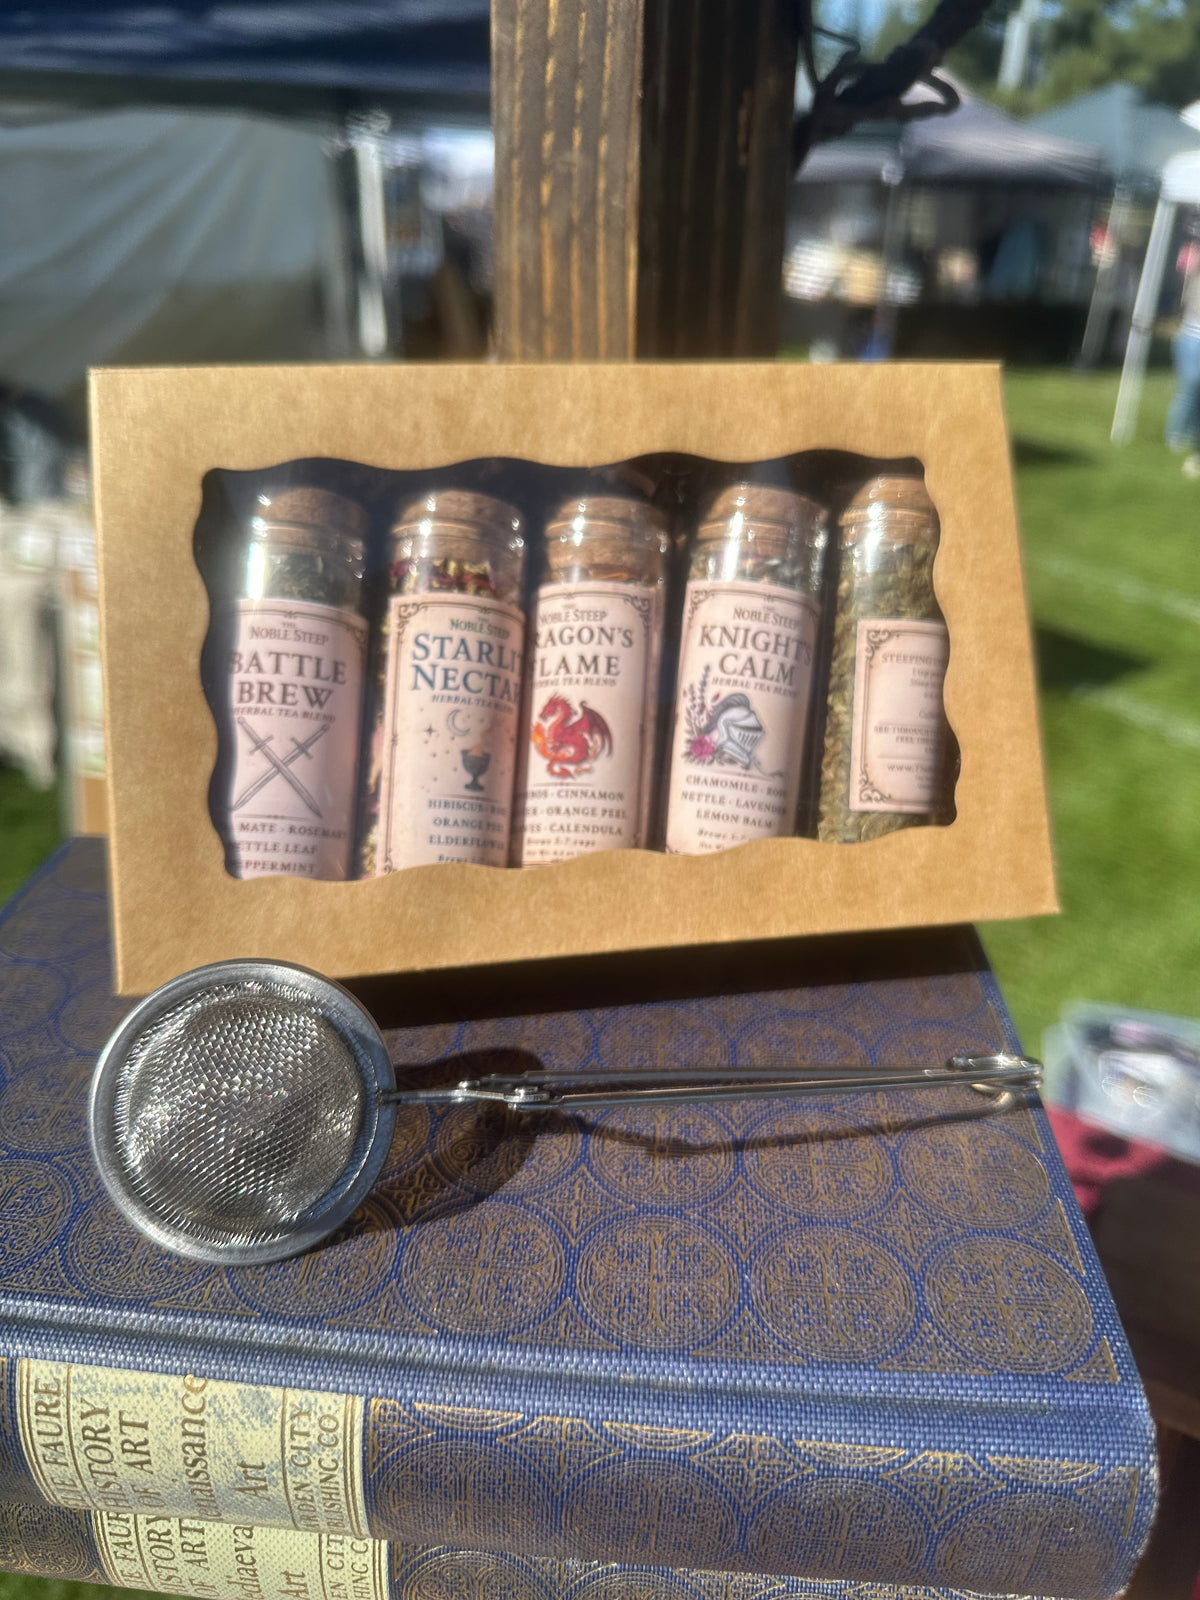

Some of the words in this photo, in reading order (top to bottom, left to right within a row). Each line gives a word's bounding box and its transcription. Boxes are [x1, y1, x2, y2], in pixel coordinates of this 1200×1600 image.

[450, 618, 485, 633] NOBLE
[573, 609, 607, 622] STEEP
[733, 607, 771, 624] NOBLE
[250, 626, 289, 640] NOBLE
[293, 630, 329, 646] STEEP
[534, 655, 621, 678] LAME
[719, 653, 795, 686] CALM
[237, 681, 334, 709] BREW
[279, 709, 299, 717] TEA
[556, 789, 625, 801] CINNAMON
[686, 774, 758, 794] CHAMOMILE
[680, 790, 726, 806] NETTLE
[546, 805, 598, 818] ORANGE
[600, 808, 627, 820] PEEL
[696, 808, 739, 824] LEMON
[742, 815, 773, 829] BALM
[549, 822, 623, 836] CALENDULA
[34, 1377, 69, 1467] FAURE
[118, 1409, 154, 1475] ART
[172, 1373, 224, 1522] enaissance
[290, 1403, 313, 1468] CITY
[79, 1397, 133, 1509] HISTORY
[232, 1460, 272, 1501] Art
[130, 1484, 166, 1508] OF
[292, 1480, 320, 1528] ARDEN
[179, 1516, 211, 1571] ART
[327, 1533, 345, 1571] CIT
[226, 1524, 264, 1600] ediaeva
[188, 1578, 220, 1597] OF
[276, 1570, 310, 1600] Art
